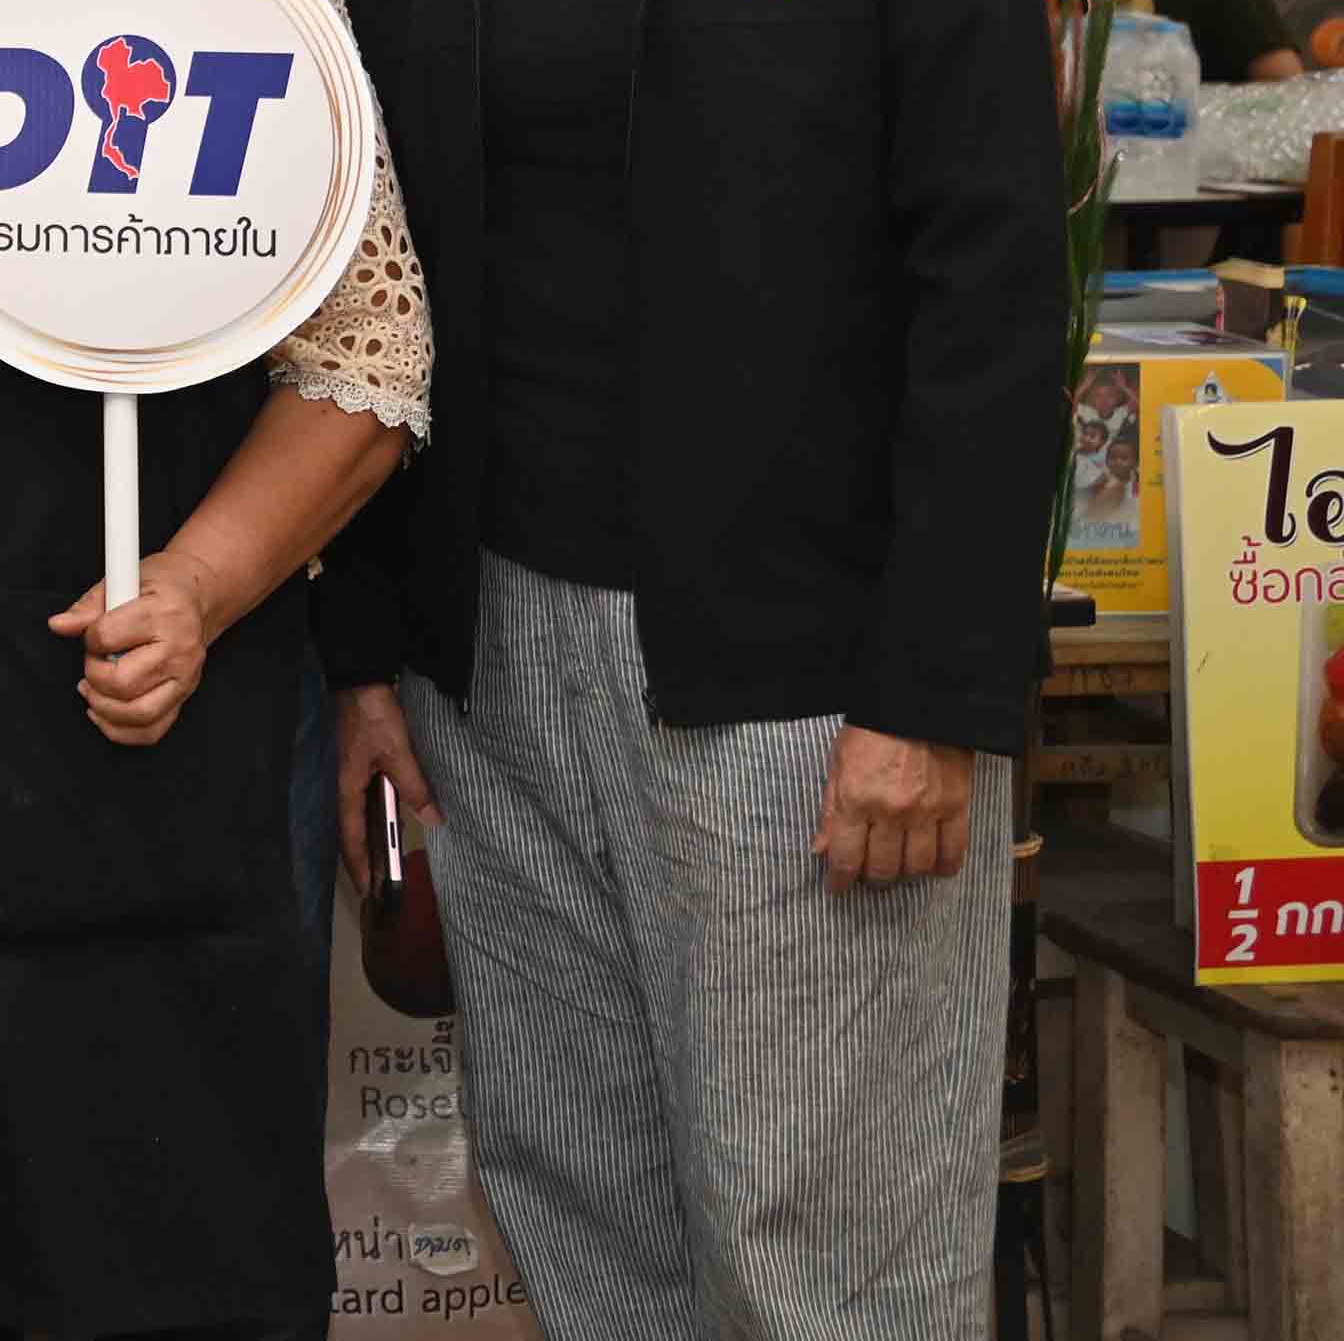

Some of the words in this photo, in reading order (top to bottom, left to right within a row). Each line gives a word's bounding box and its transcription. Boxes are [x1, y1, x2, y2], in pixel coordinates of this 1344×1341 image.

[347, 1019, 464, 1075] กระเจี๊
[421, 1273, 529, 1321] apple
